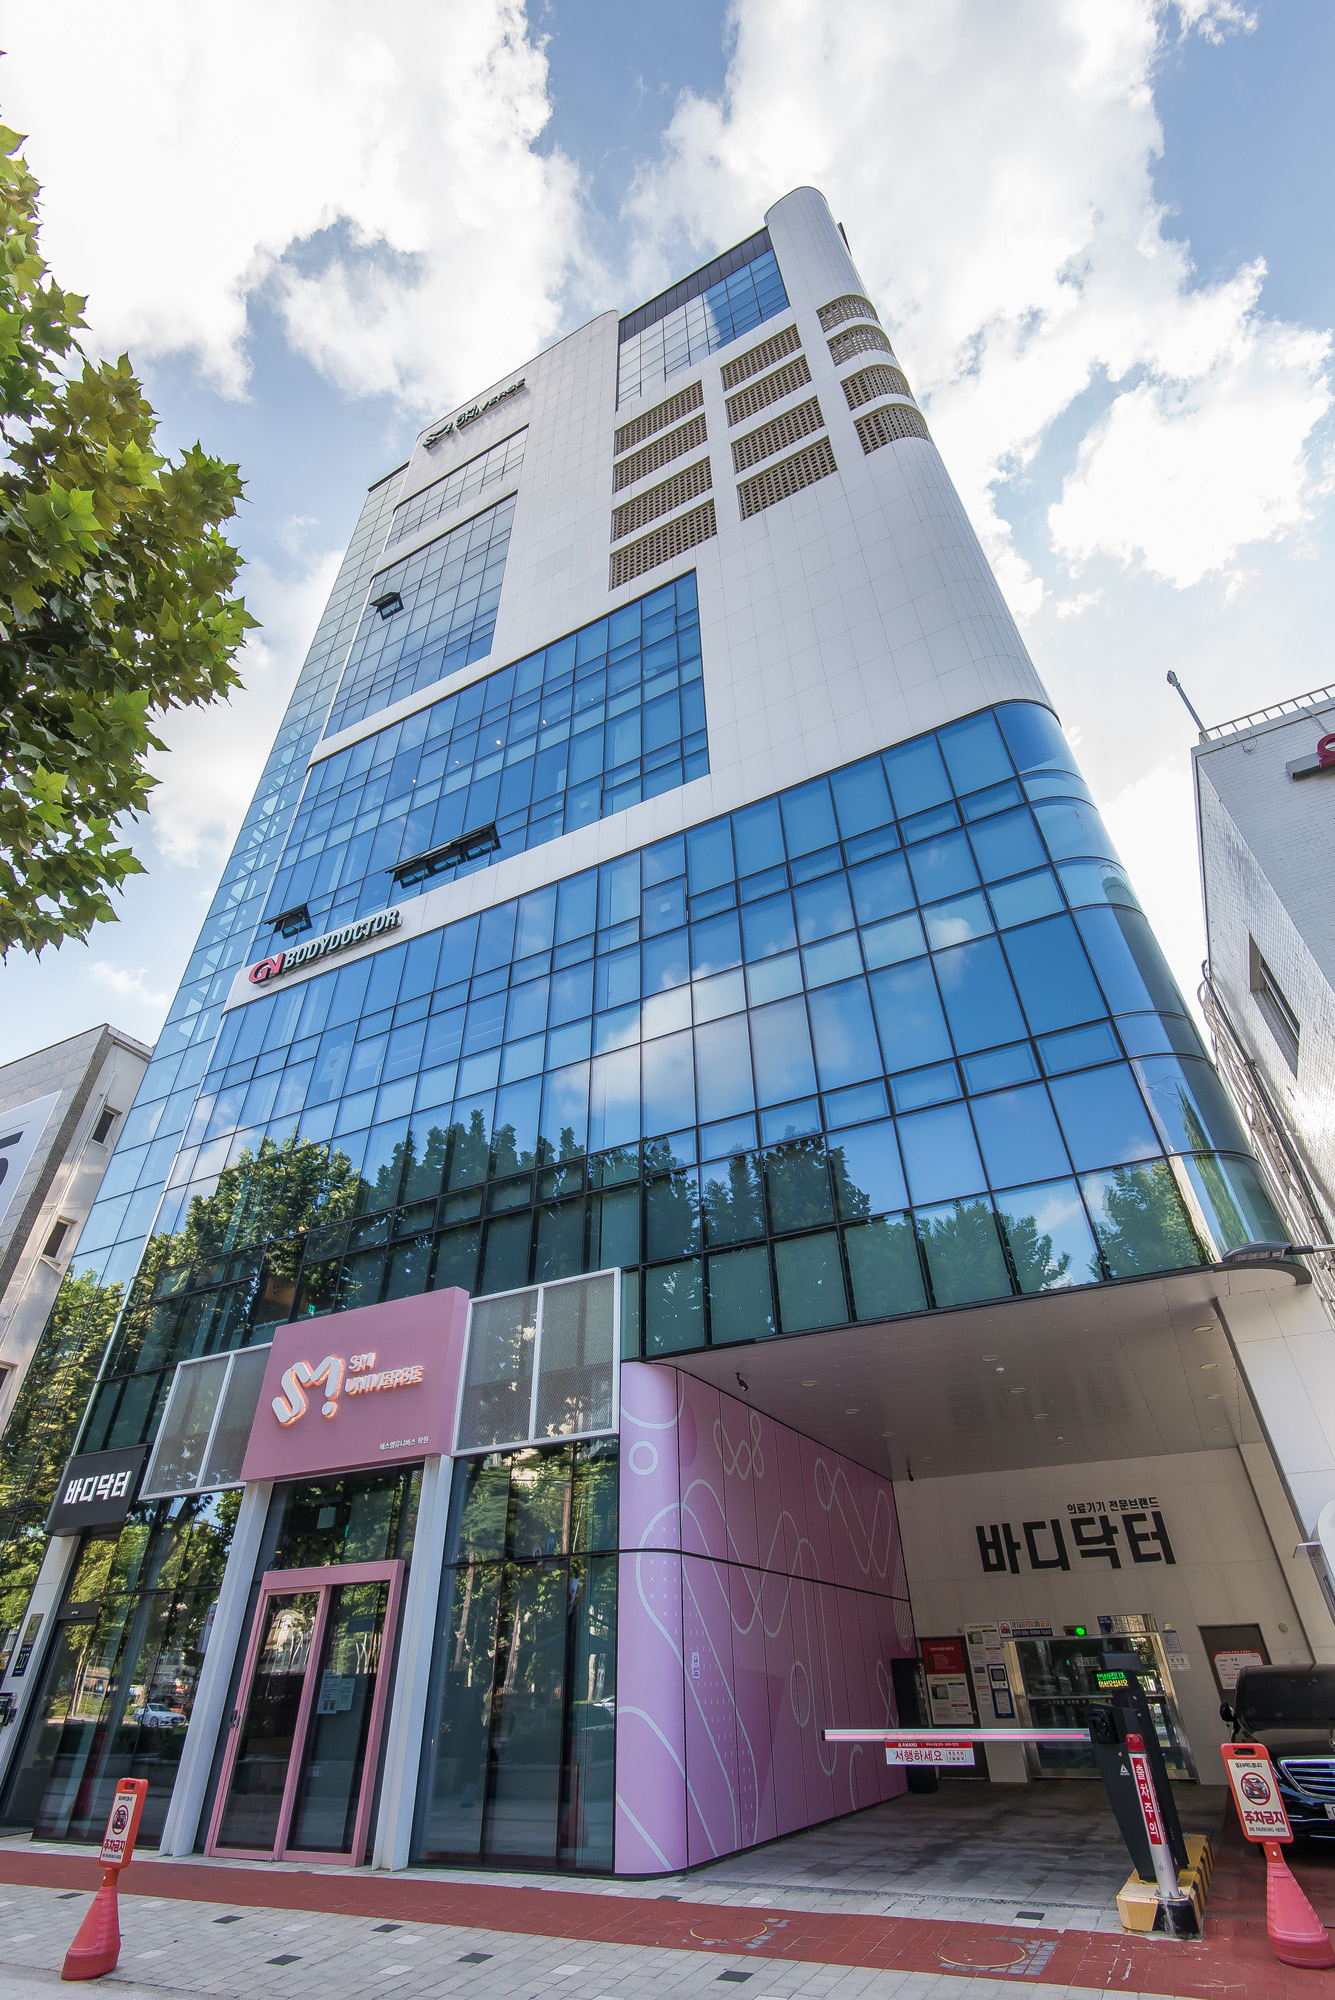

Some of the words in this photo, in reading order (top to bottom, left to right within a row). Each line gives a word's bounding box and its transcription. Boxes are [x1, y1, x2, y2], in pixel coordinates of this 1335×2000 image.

[283, 909, 399, 969] BODYDOCTOR
[349, 1352, 375, 1370] SM
[345, 1365, 423, 1393] UNIVERSE
[379, 1438, 416, 1450] 에스엠유니버스
[417, 1436, 429, 1444] 학원
[63, 1471, 132, 1504] 바디닥터
[1067, 1501, 1106, 1514] 의료기기
[1108, 1497, 1160, 1511] 전문브랜드
[975, 1511, 1177, 1574] 바디닥터
[895, 1750, 943, 1762] 서행하세요
[1243, 1811, 1285, 1825] 주차금지
[104, 1839, 125, 1853] 주차금지
